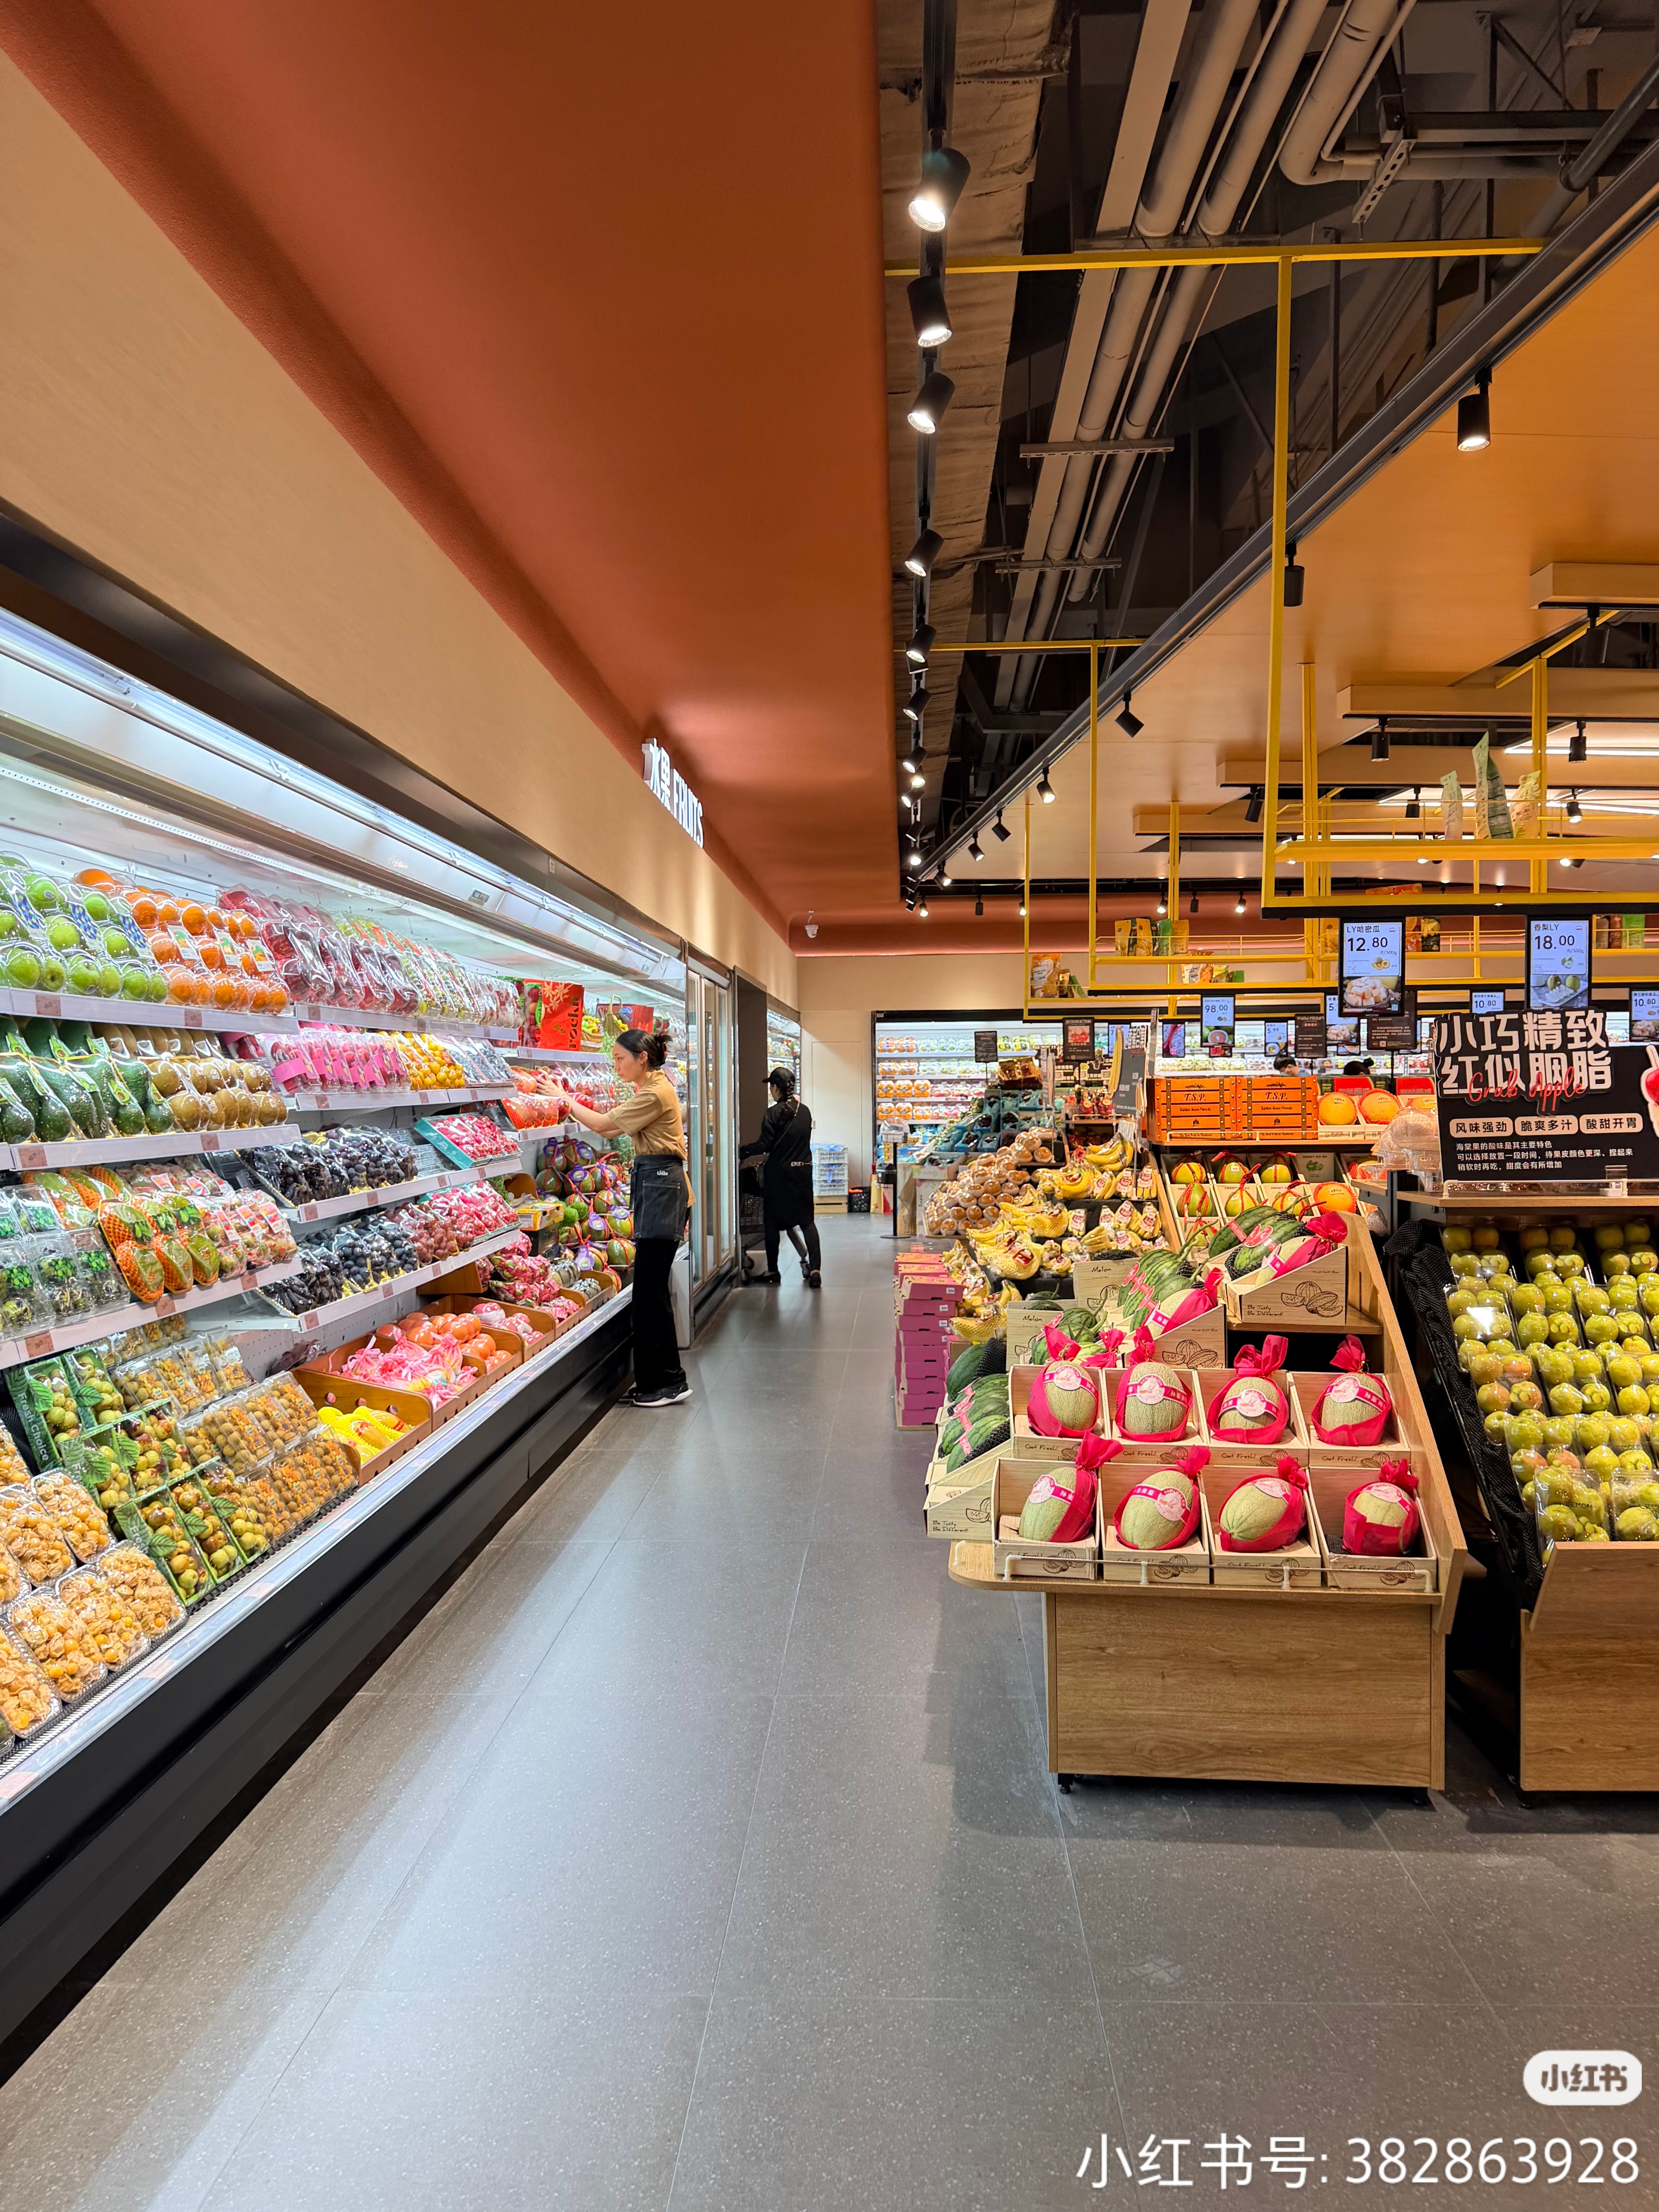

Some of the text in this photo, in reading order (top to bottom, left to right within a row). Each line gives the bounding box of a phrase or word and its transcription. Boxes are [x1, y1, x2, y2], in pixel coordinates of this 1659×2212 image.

[649, 737, 703, 849] 水果 FRUITS
[1348, 937, 1388, 951] 12.80
[1535, 935, 1575, 949] 18.00
[1440, 1010, 1606, 1053] 小巧精致
[1441, 1051, 1611, 1094] 红似胭脂
[1529, 1066, 1586, 1112] Apple
[1455, 1121, 1507, 1133] 风味强劲
[1521, 1120, 1572, 1131] 脆爽多汁
[1586, 1118, 1636, 1129] 酸甜开胃
[1456, 1141, 1552, 1151] 海棠果的酸味是其主要特色
[1458, 1161, 1562, 1171] 稍软时再吃，甜度会有所增加
[18, 1393, 49, 1460] Fresh Choice
